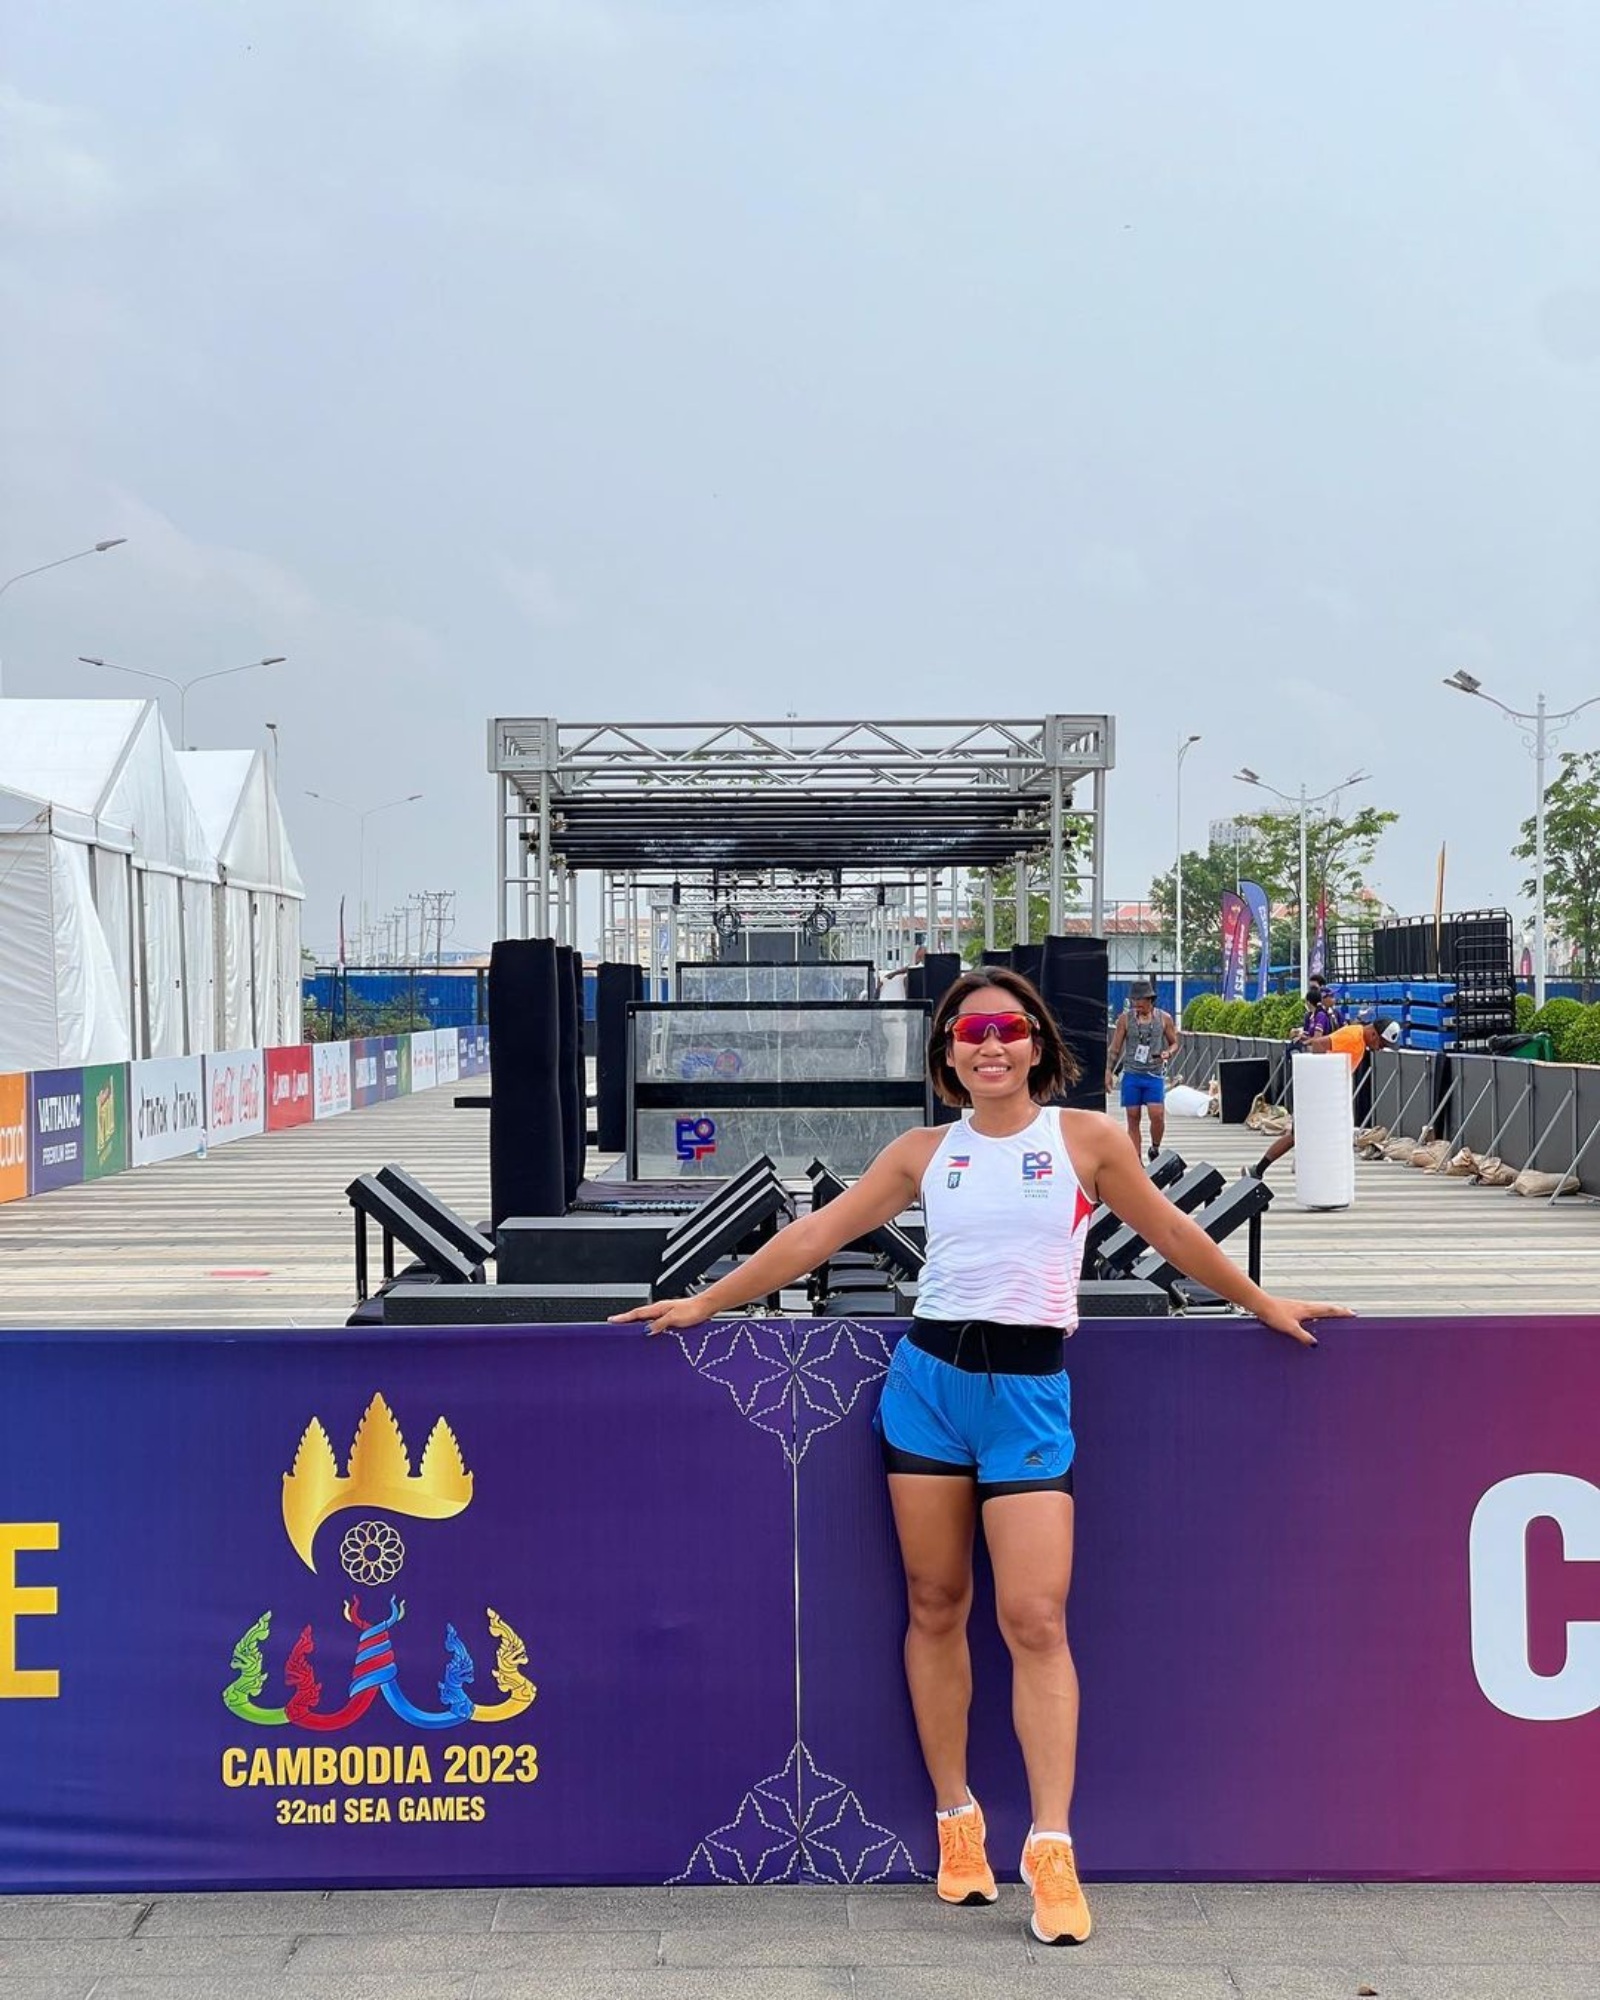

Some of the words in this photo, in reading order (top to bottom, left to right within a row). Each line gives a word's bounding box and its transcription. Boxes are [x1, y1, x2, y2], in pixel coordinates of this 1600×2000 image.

[38, 1094, 81, 1133] VATTANAC
[0, 1522, 60, 1698] E
[1469, 1472, 1600, 1721] C
[222, 1746, 432, 1788] CAMBODIA
[443, 1744, 539, 1784] 2023
[276, 1799, 337, 1825] 32nd
[344, 1798, 391, 1824] SEA
[398, 1796, 486, 1823] GAMES
